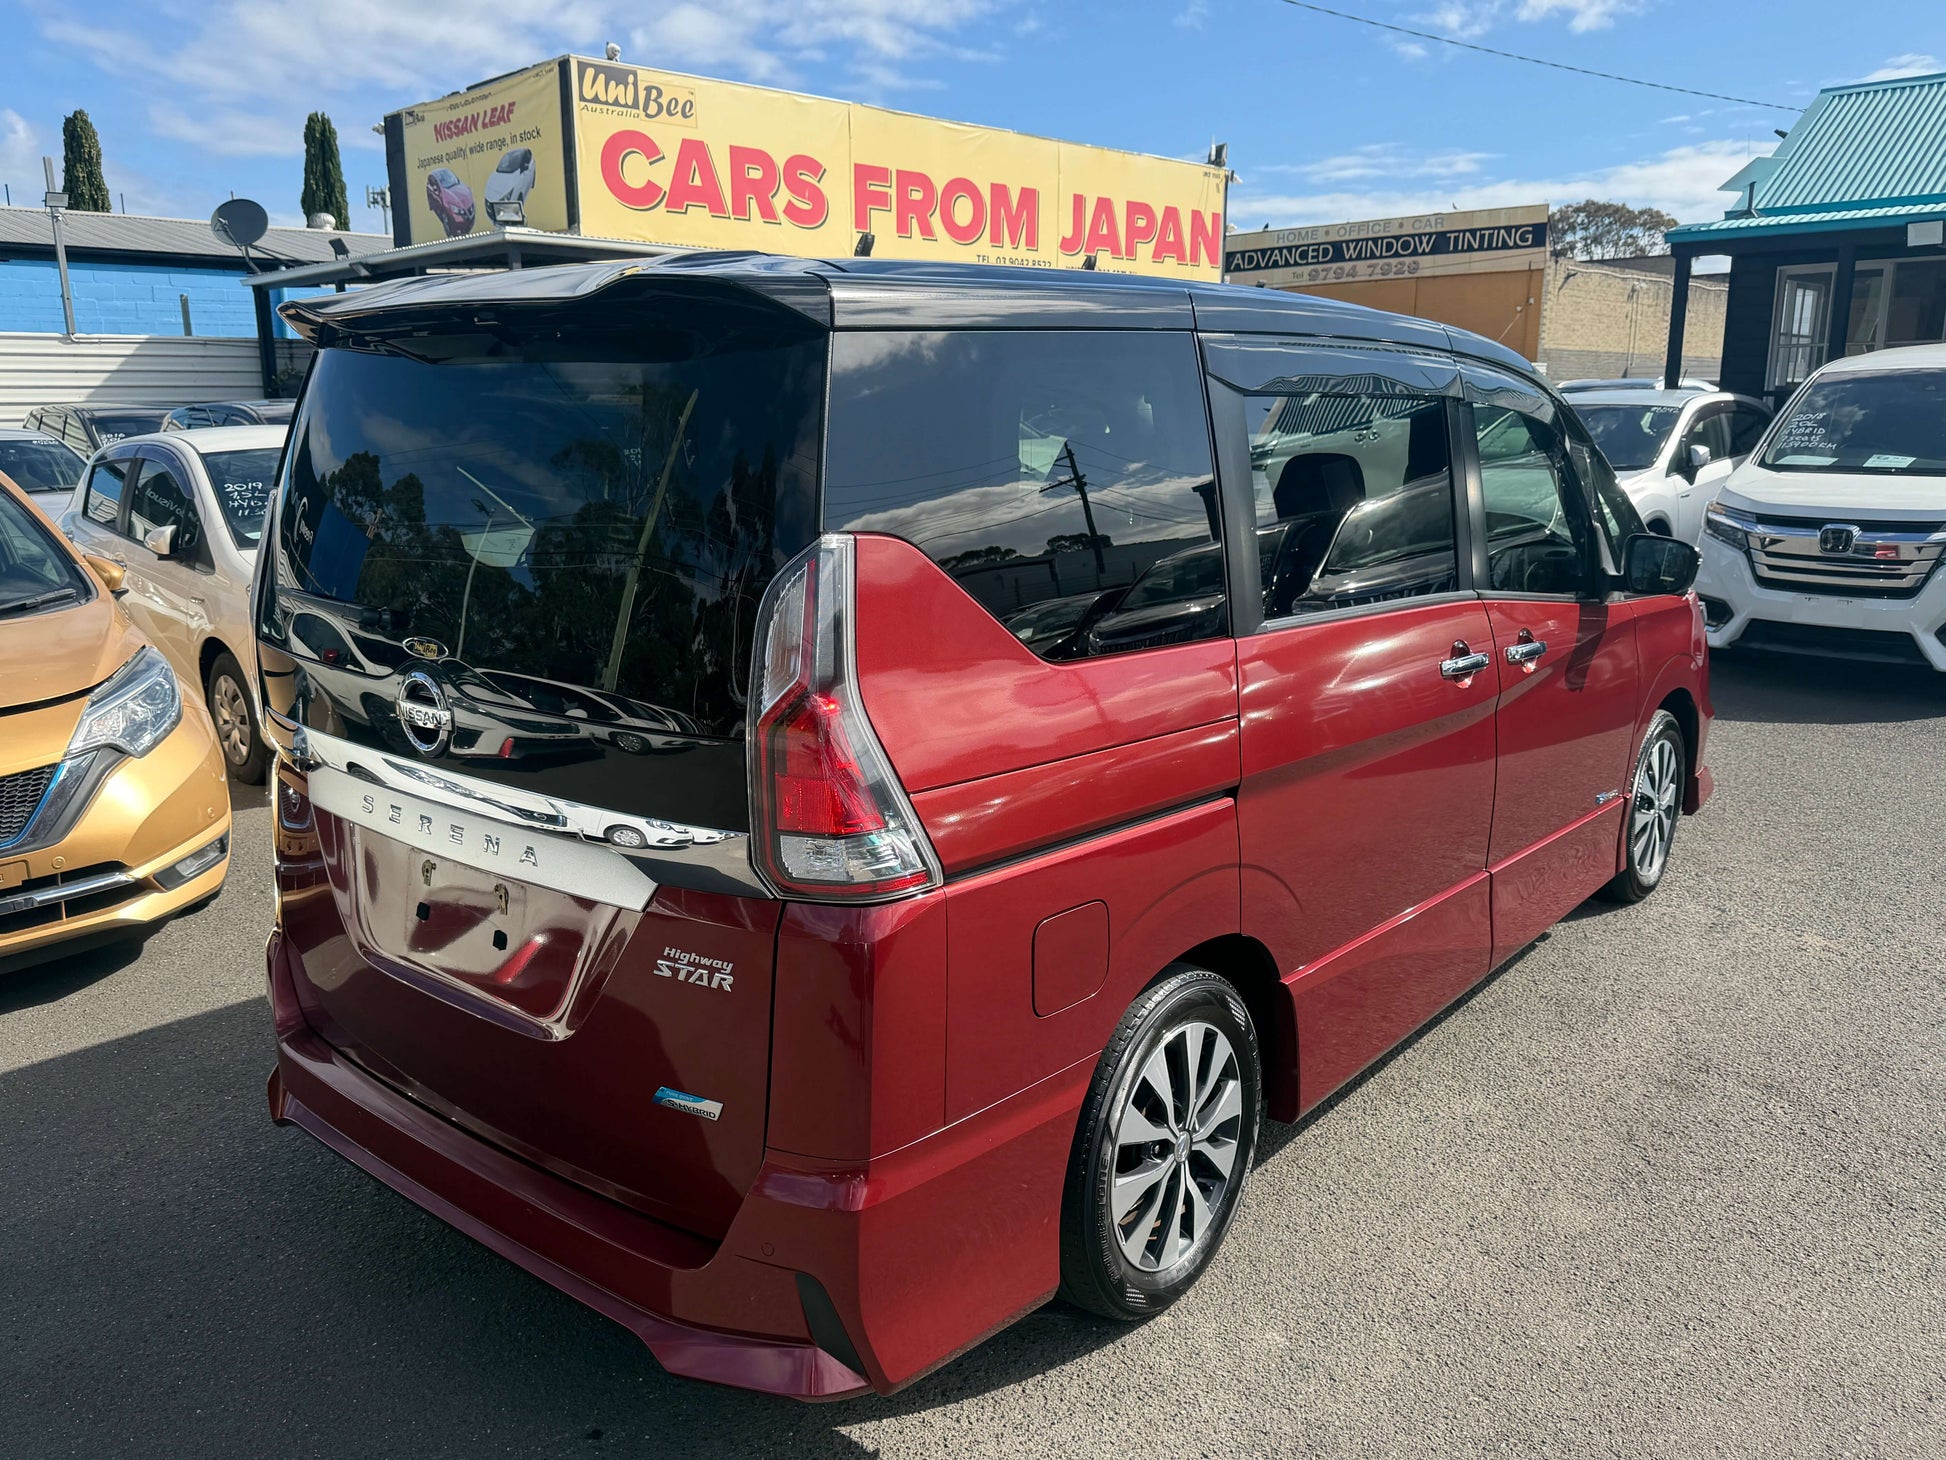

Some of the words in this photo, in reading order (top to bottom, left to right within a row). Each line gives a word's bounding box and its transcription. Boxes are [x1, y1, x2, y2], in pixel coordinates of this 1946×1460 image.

[433, 111, 480, 143] NISSAN
[482, 101, 517, 130] LEAF
[580, 104, 640, 119] Australia
[417, 153, 444, 169] Japanese
[468, 140, 485, 155] wide
[486, 138, 509, 151] range,
[510, 132, 518, 145] in
[519, 125, 542, 142] stock
[600, 129, 829, 229] CARS
[854, 163, 1039, 251] FROM
[1059, 193, 1221, 268] JAPAN
[1276, 229, 1319, 244] HOME
[1336, 221, 1391, 238] OFFICE
[1411, 216, 1445, 231] CAR
[1230, 244, 1333, 271] ADVANCED
[1342, 234, 1437, 260] WINDOW
[1446, 226, 1533, 252] TINTING
[1291, 271, 1304, 280] Tel
[1307, 265, 1358, 282] 9794
[1367, 260, 1421, 278] 7929
[224, 481, 263, 491] 2019
[400, 703, 442, 728] NISSAN
[362, 794, 539, 867] SERENA
[663, 946, 734, 974] Highway
[653, 959, 734, 993] STAR
